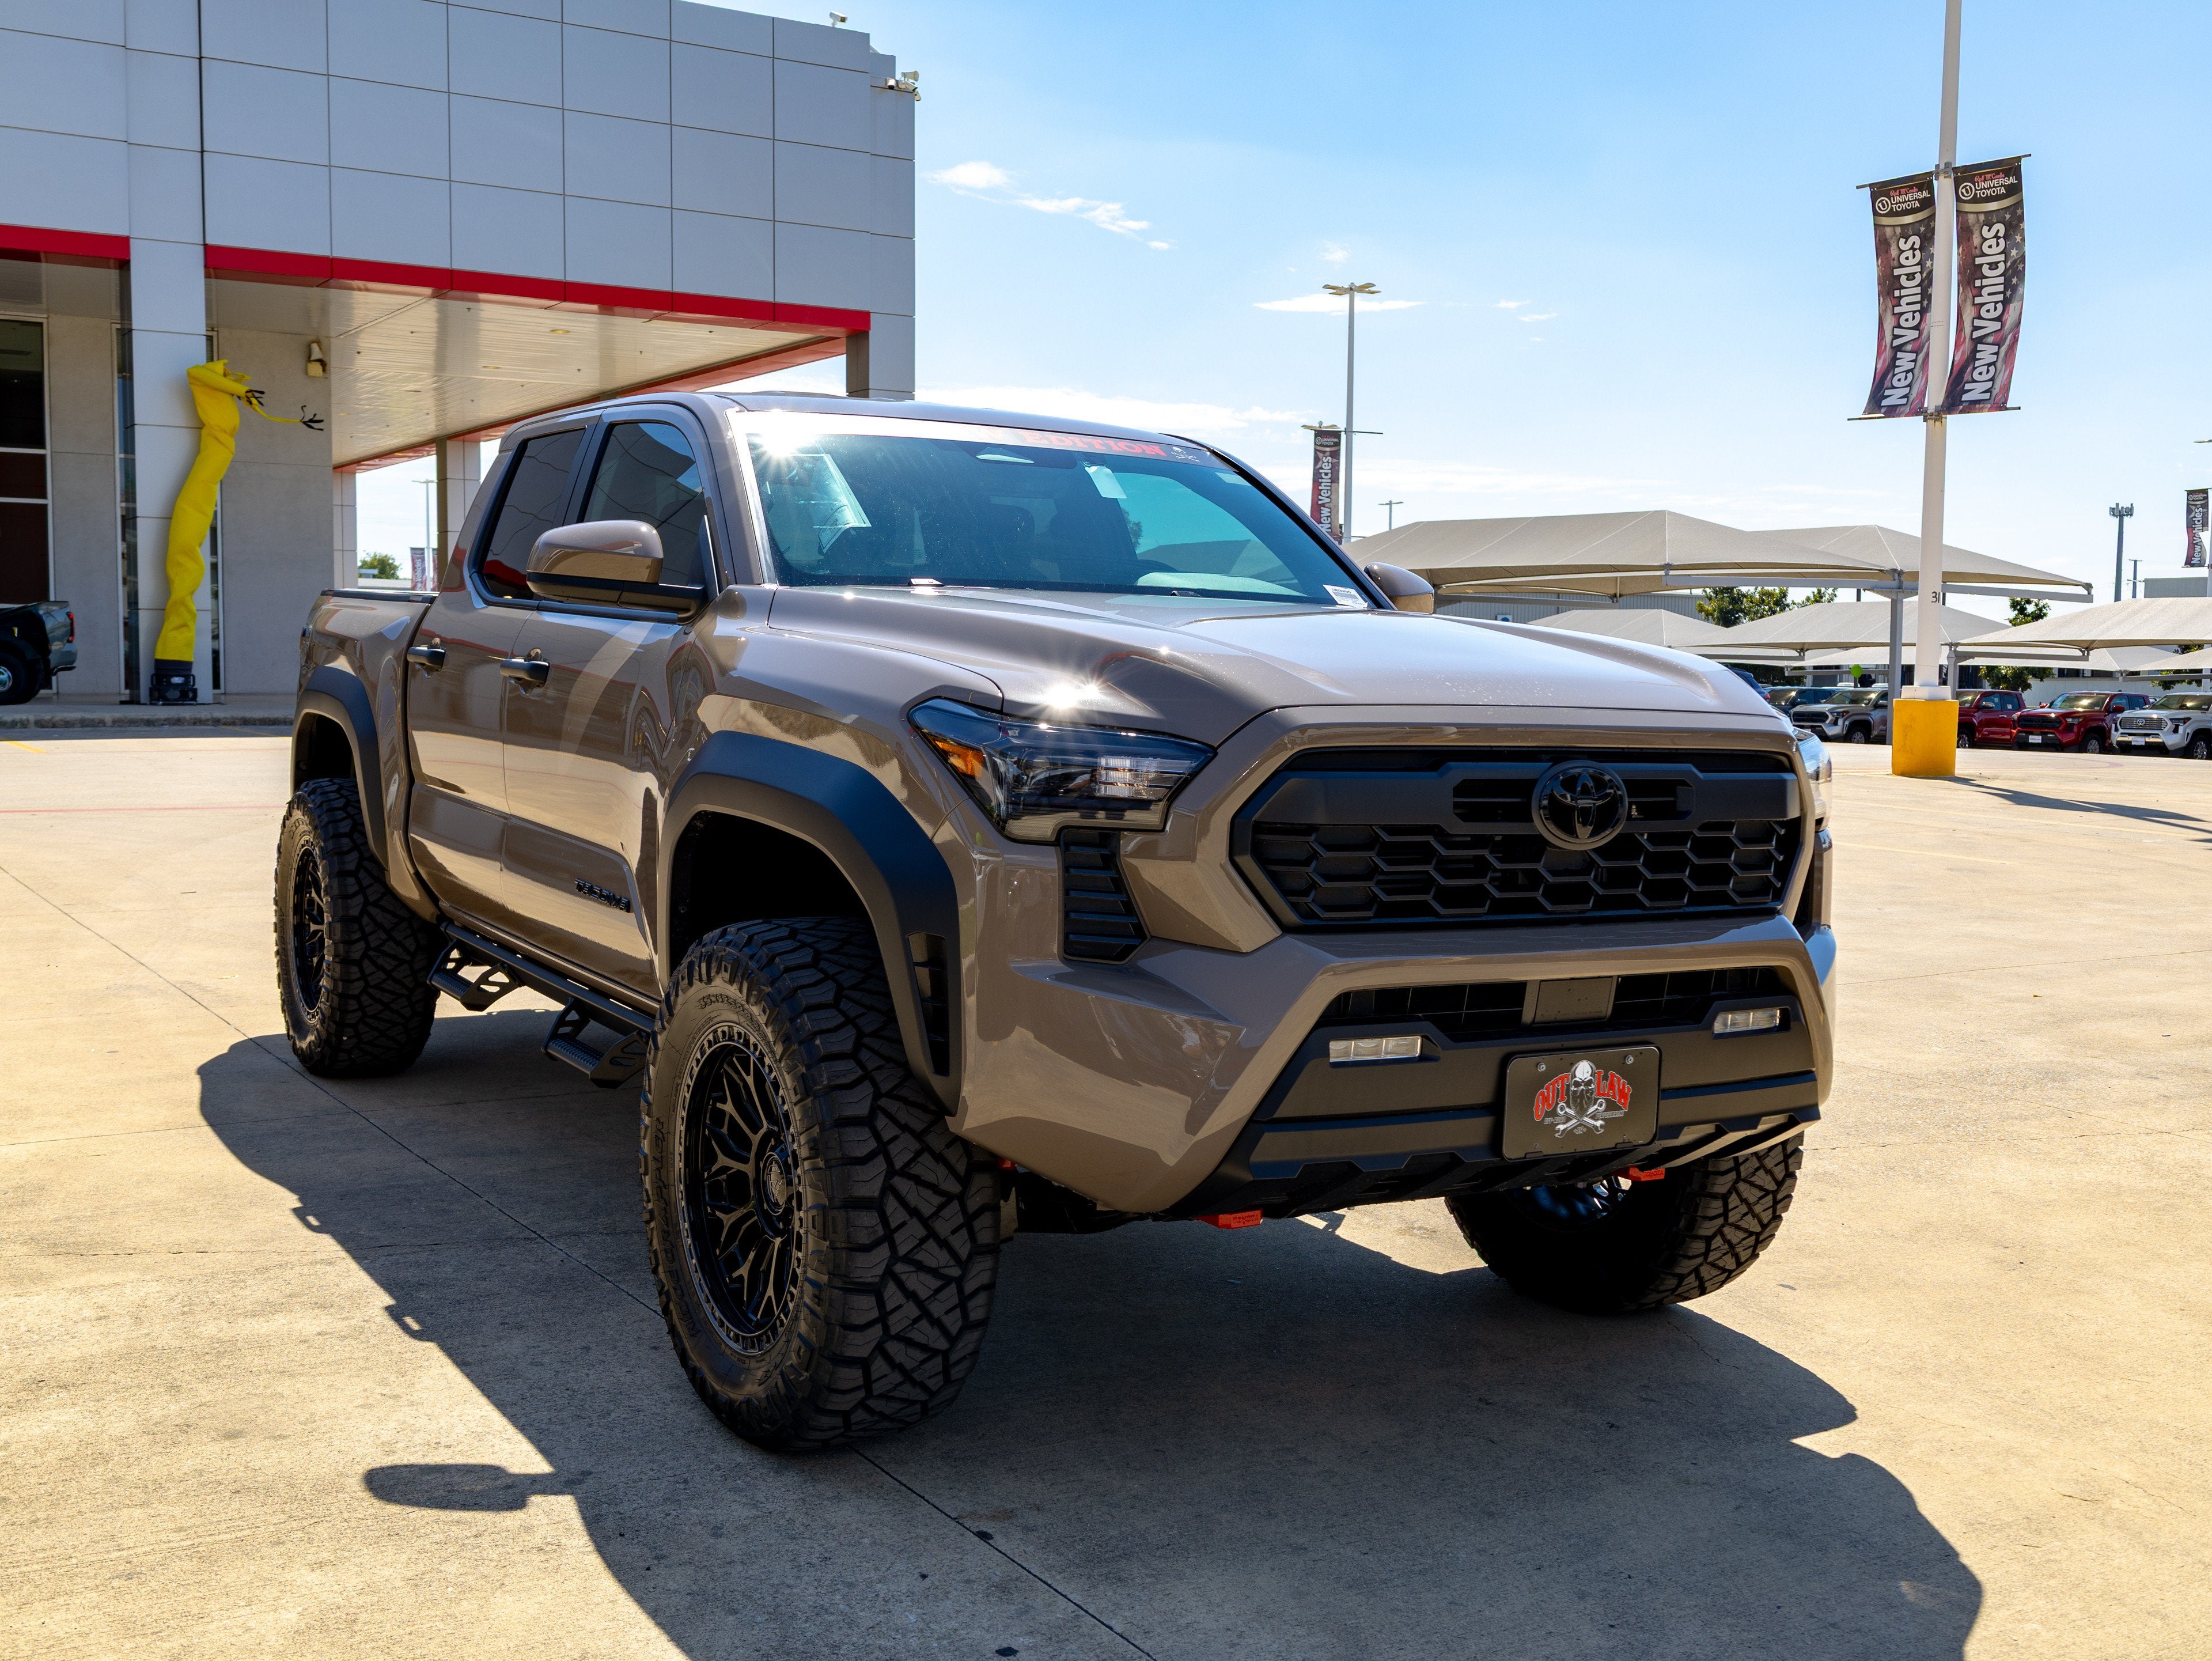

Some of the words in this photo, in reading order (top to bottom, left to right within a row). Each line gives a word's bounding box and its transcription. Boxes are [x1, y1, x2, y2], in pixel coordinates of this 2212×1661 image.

[1975, 176, 2018, 190] UNIVERSAL
[1975, 187, 2006, 198] TOYOTA
[1891, 190, 1930, 203] UNIVERSAL
[1891, 200, 1920, 211] TOYOTA
[1892, 234, 1922, 347] Vehicles
[1972, 222, 2006, 340] Vehicles
[1881, 351, 1916, 407] New
[1961, 344, 1999, 402] New
[1018, 431, 1167, 457] EDITION
[1318, 456, 1332, 505] Vehicles
[2191, 545, 2201, 564] New
